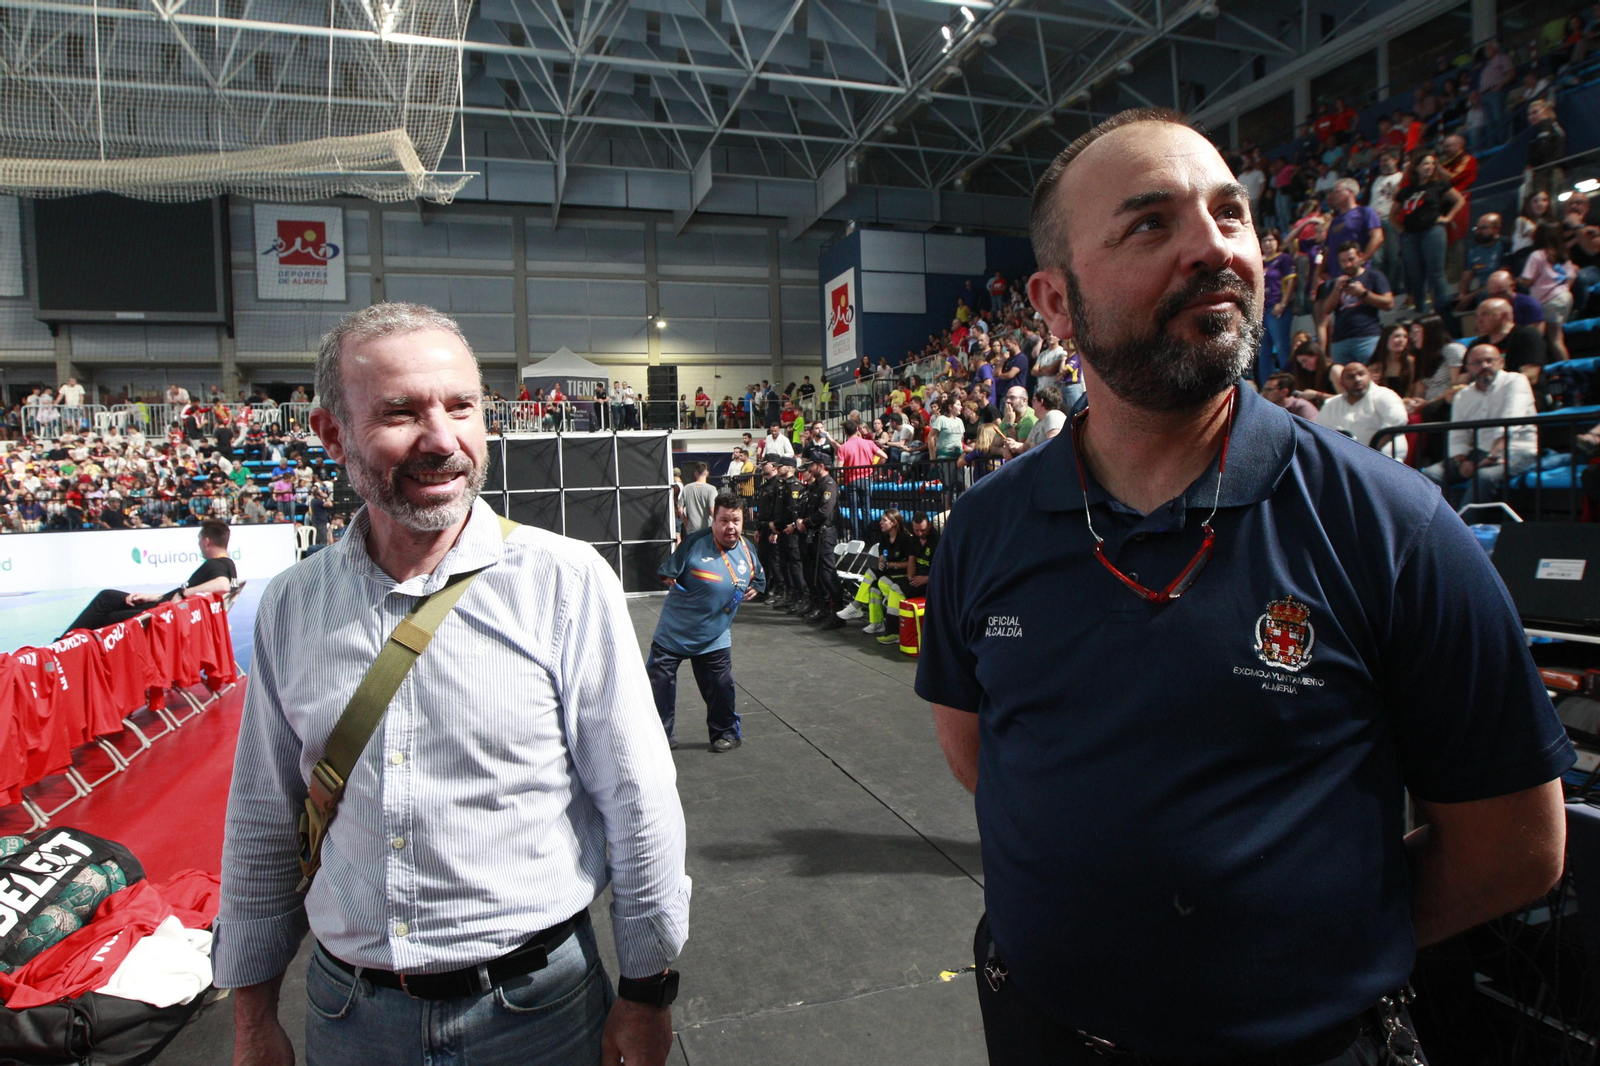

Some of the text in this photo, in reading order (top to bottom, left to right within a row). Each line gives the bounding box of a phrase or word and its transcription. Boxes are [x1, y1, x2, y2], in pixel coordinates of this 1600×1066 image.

[278, 271, 328, 279] DEPORTES
[278, 277, 290, 285] DE
[567, 380, 605, 397] TIEND
[148, 547, 241, 567] quirónsd
[988, 616, 1020, 626] OFICIAL
[985, 625, 1022, 637] ALCALDÍA
